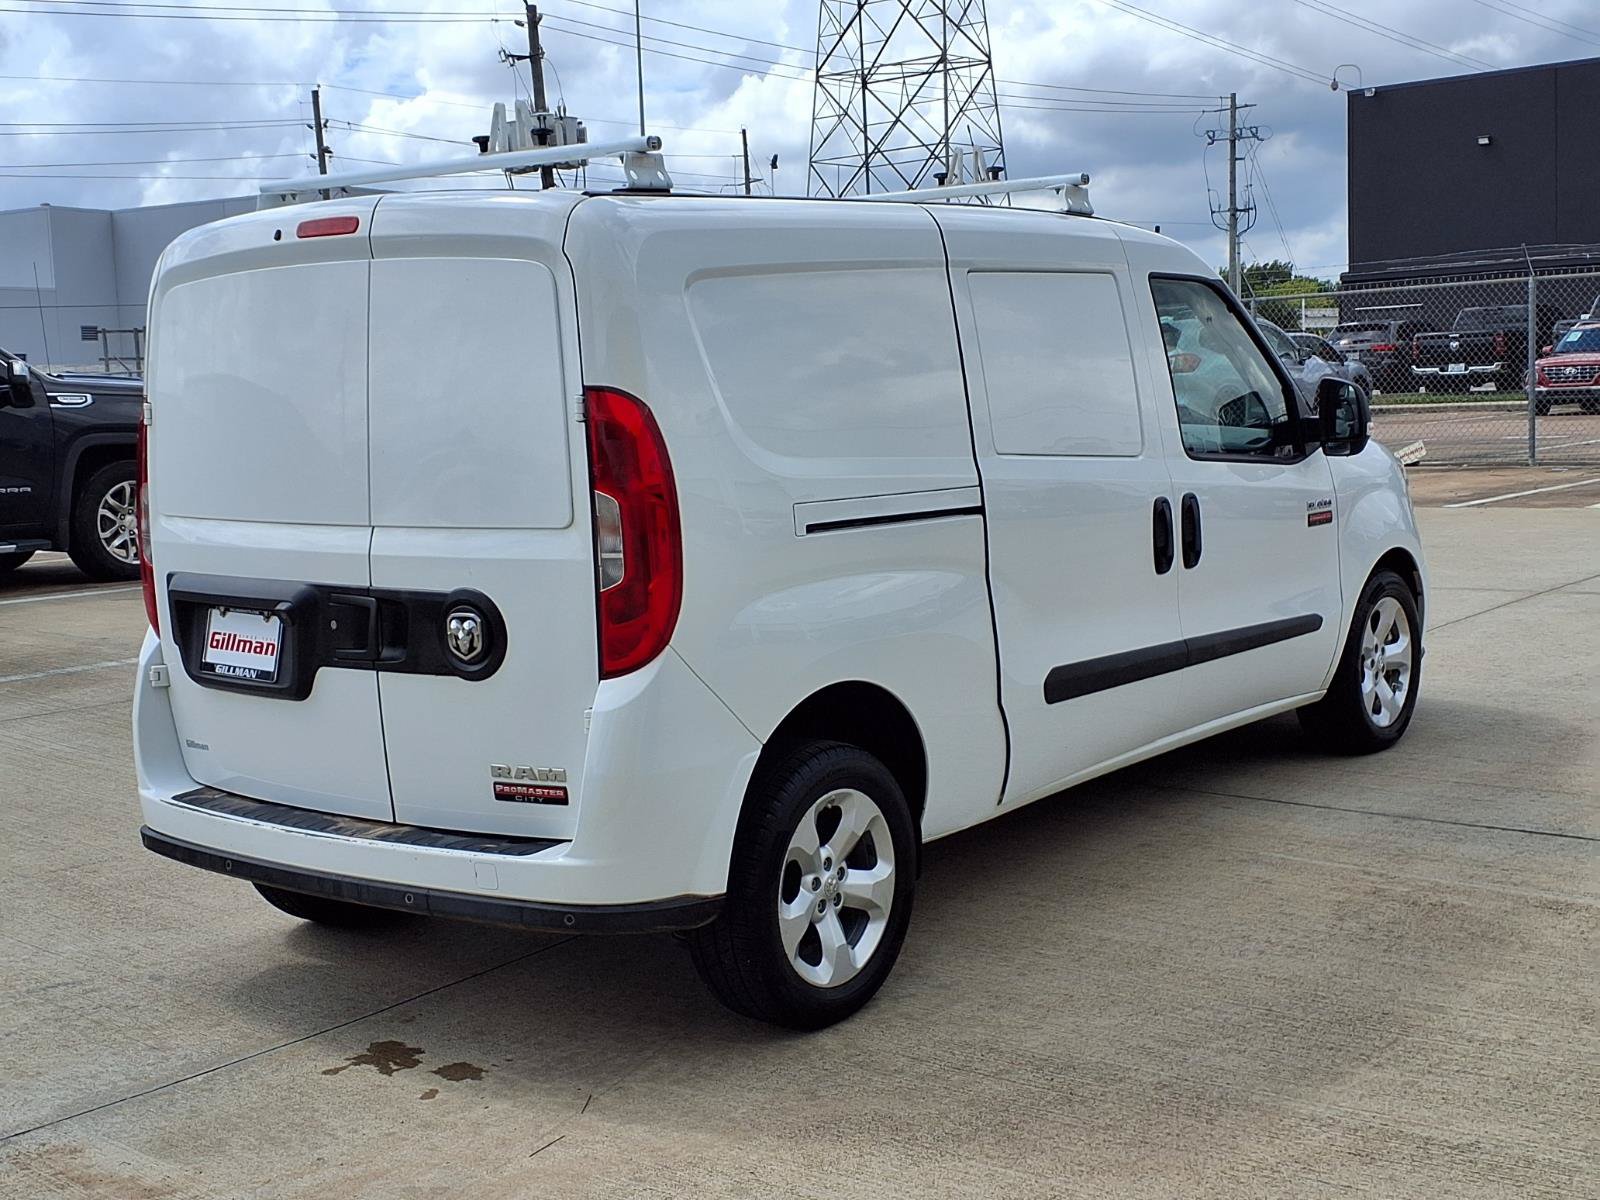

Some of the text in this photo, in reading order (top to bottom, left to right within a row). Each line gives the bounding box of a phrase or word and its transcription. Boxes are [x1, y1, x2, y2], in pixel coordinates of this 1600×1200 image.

[209, 631, 276, 657] Gillman
[214, 664, 258, 679] GILLMAN
[490, 763, 567, 783] RAM
[515, 795, 545, 803] CITY
